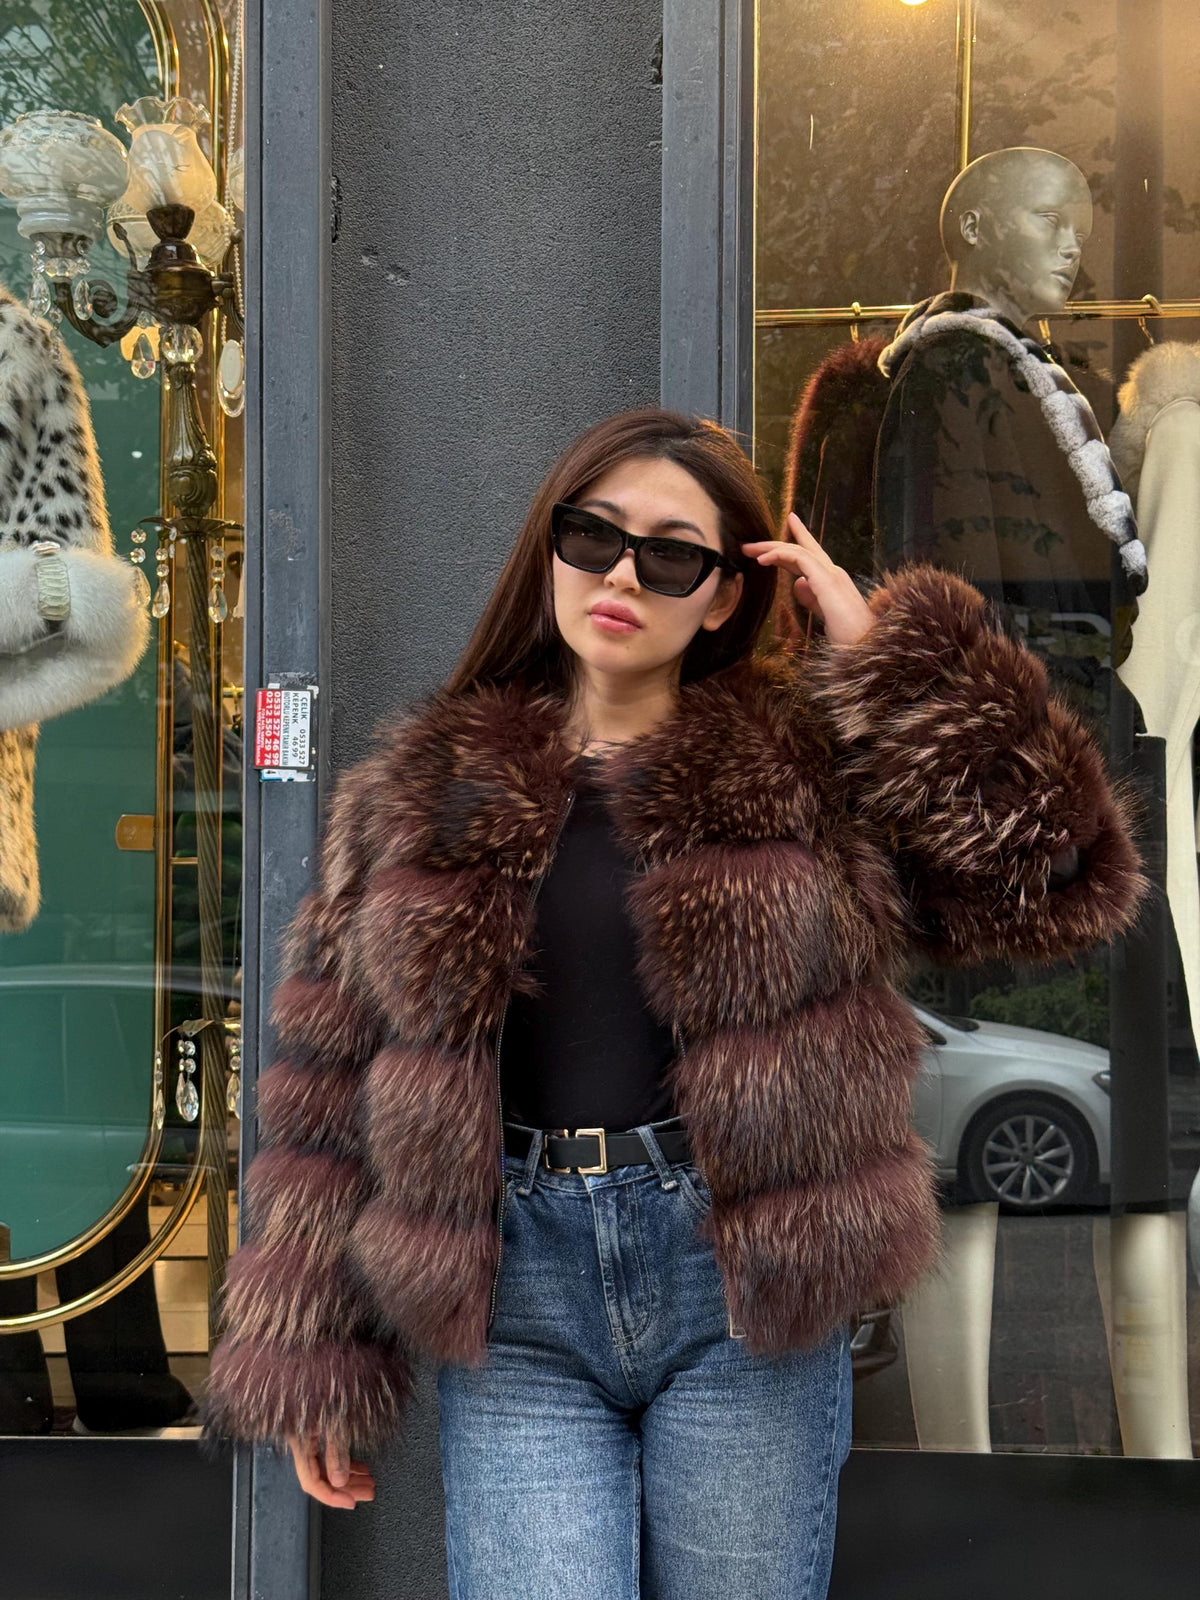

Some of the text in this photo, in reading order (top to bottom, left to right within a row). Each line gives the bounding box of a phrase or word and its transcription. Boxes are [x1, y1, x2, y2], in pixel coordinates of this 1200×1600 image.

[264, 738, 271, 751] 29
[272, 738, 279, 751] 46
[292, 736, 299, 758] 46 99
[264, 752, 271, 766] 78
[272, 752, 279, 765] 99
